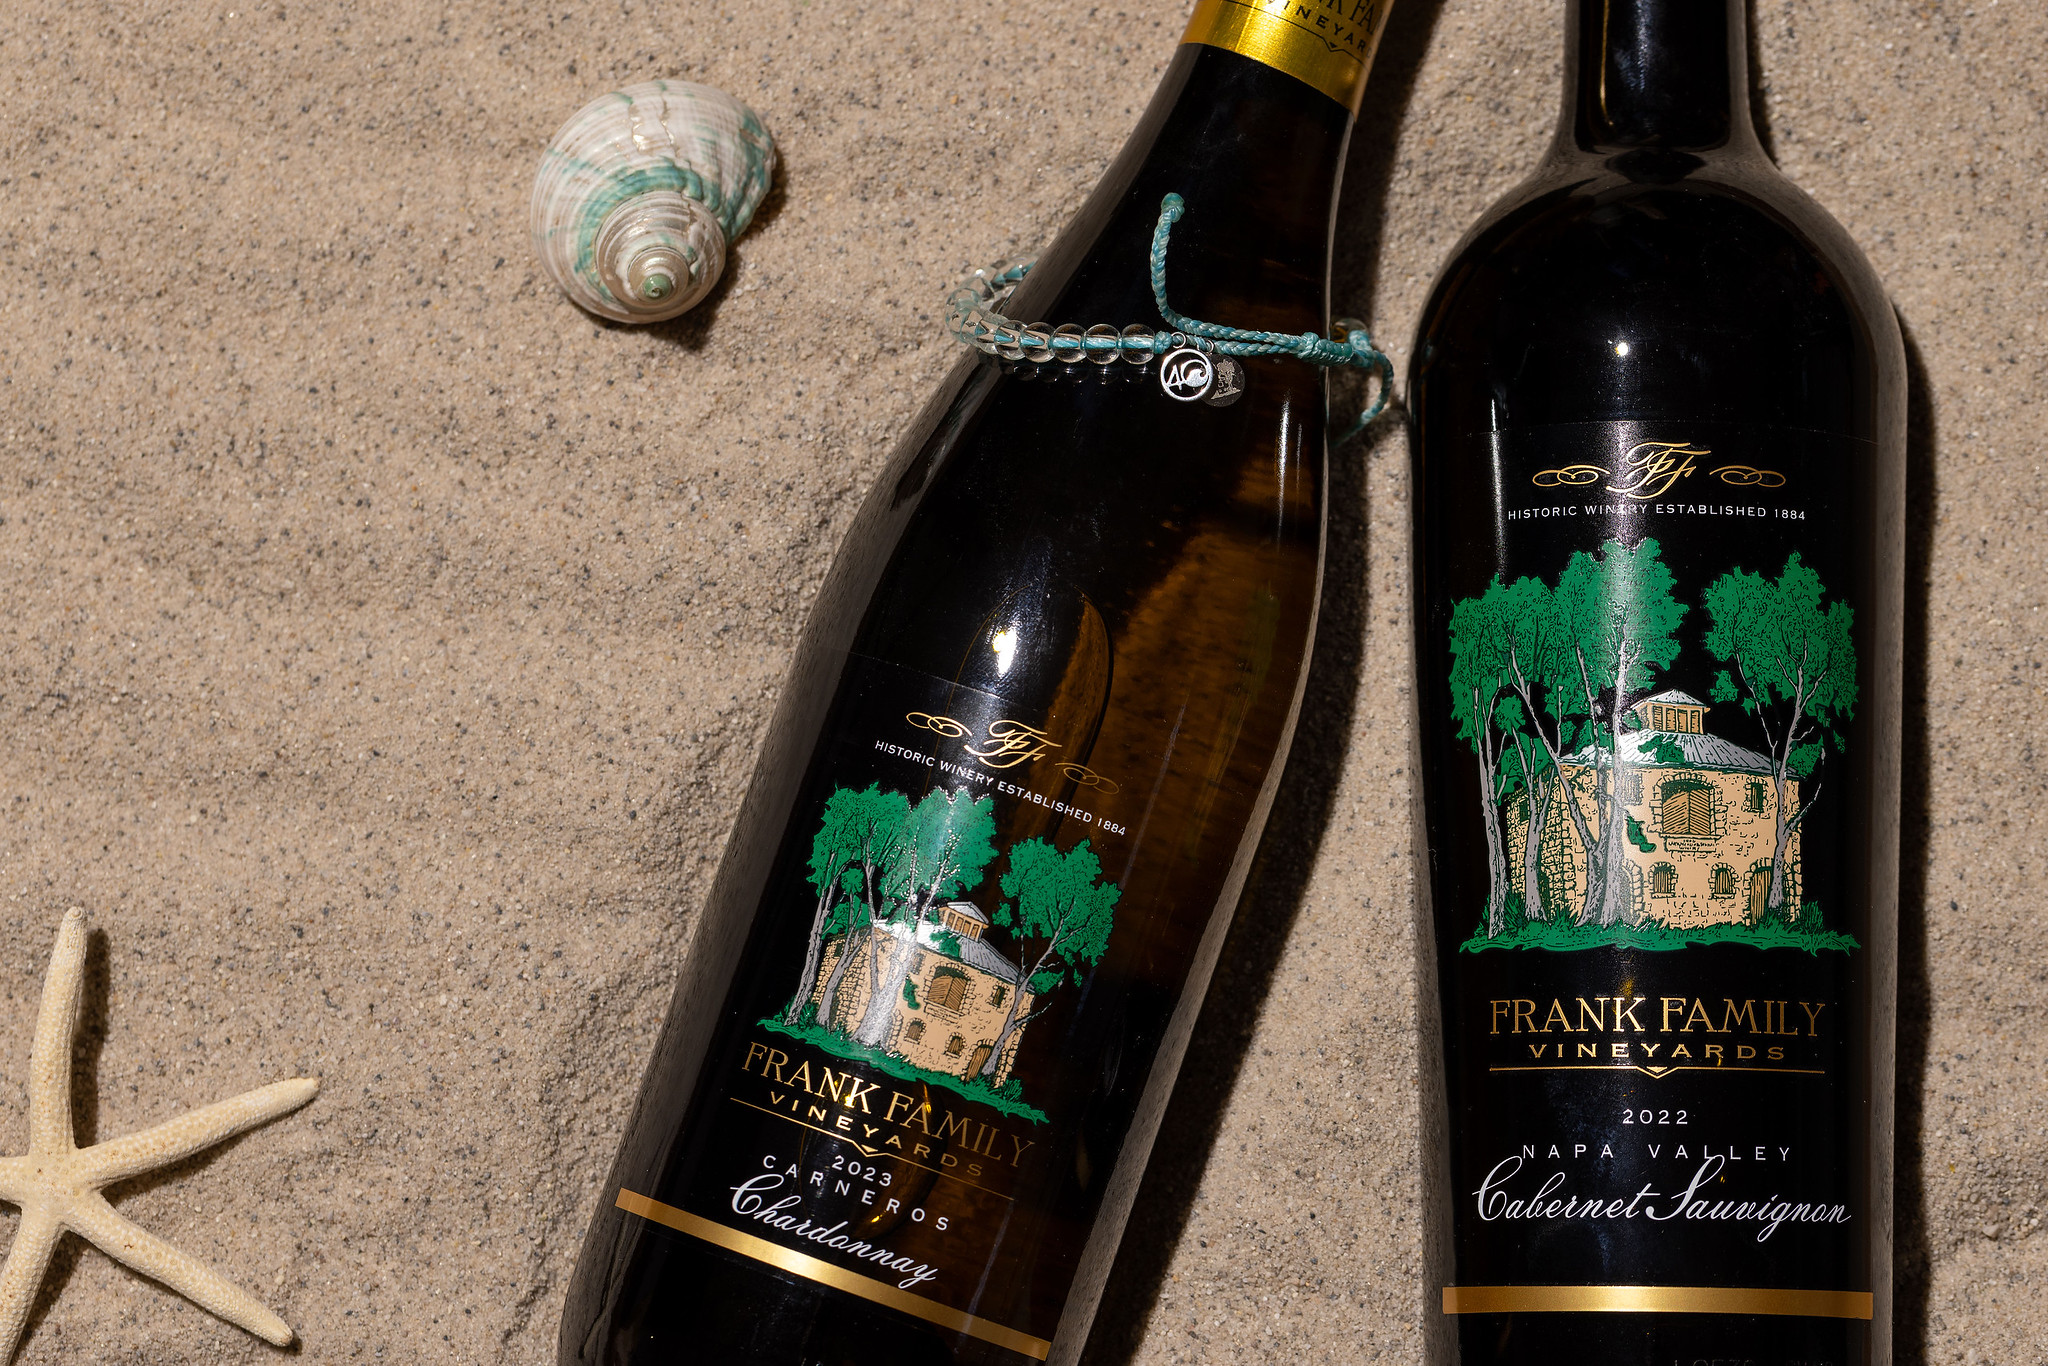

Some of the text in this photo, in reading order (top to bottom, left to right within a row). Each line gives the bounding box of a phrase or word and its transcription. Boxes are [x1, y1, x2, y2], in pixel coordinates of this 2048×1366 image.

[1508, 503, 1806, 521] HISTORIC WINERY ESTABLISHED 1884
[874, 740, 1127, 836] HISTORIC WINERY ESTABLISHED 1884
[1490, 996, 1826, 1037] FRANK FAMILY
[1528, 1042, 1785, 1061] VINEYARDS
[741, 1041, 1036, 1168] FRANK FAMILY
[1621, 1108, 1689, 1125] 2022
[769, 1091, 983, 1177] VINEYARDS
[1522, 1144, 1791, 1161] NAPA VALLEY
[763, 1155, 949, 1231] CARNEROS
[832, 1155, 892, 1187] 2023
[1472, 1154, 1852, 1242] Cabernet Sauvignon
[730, 1173, 937, 1289] Chardonnay
